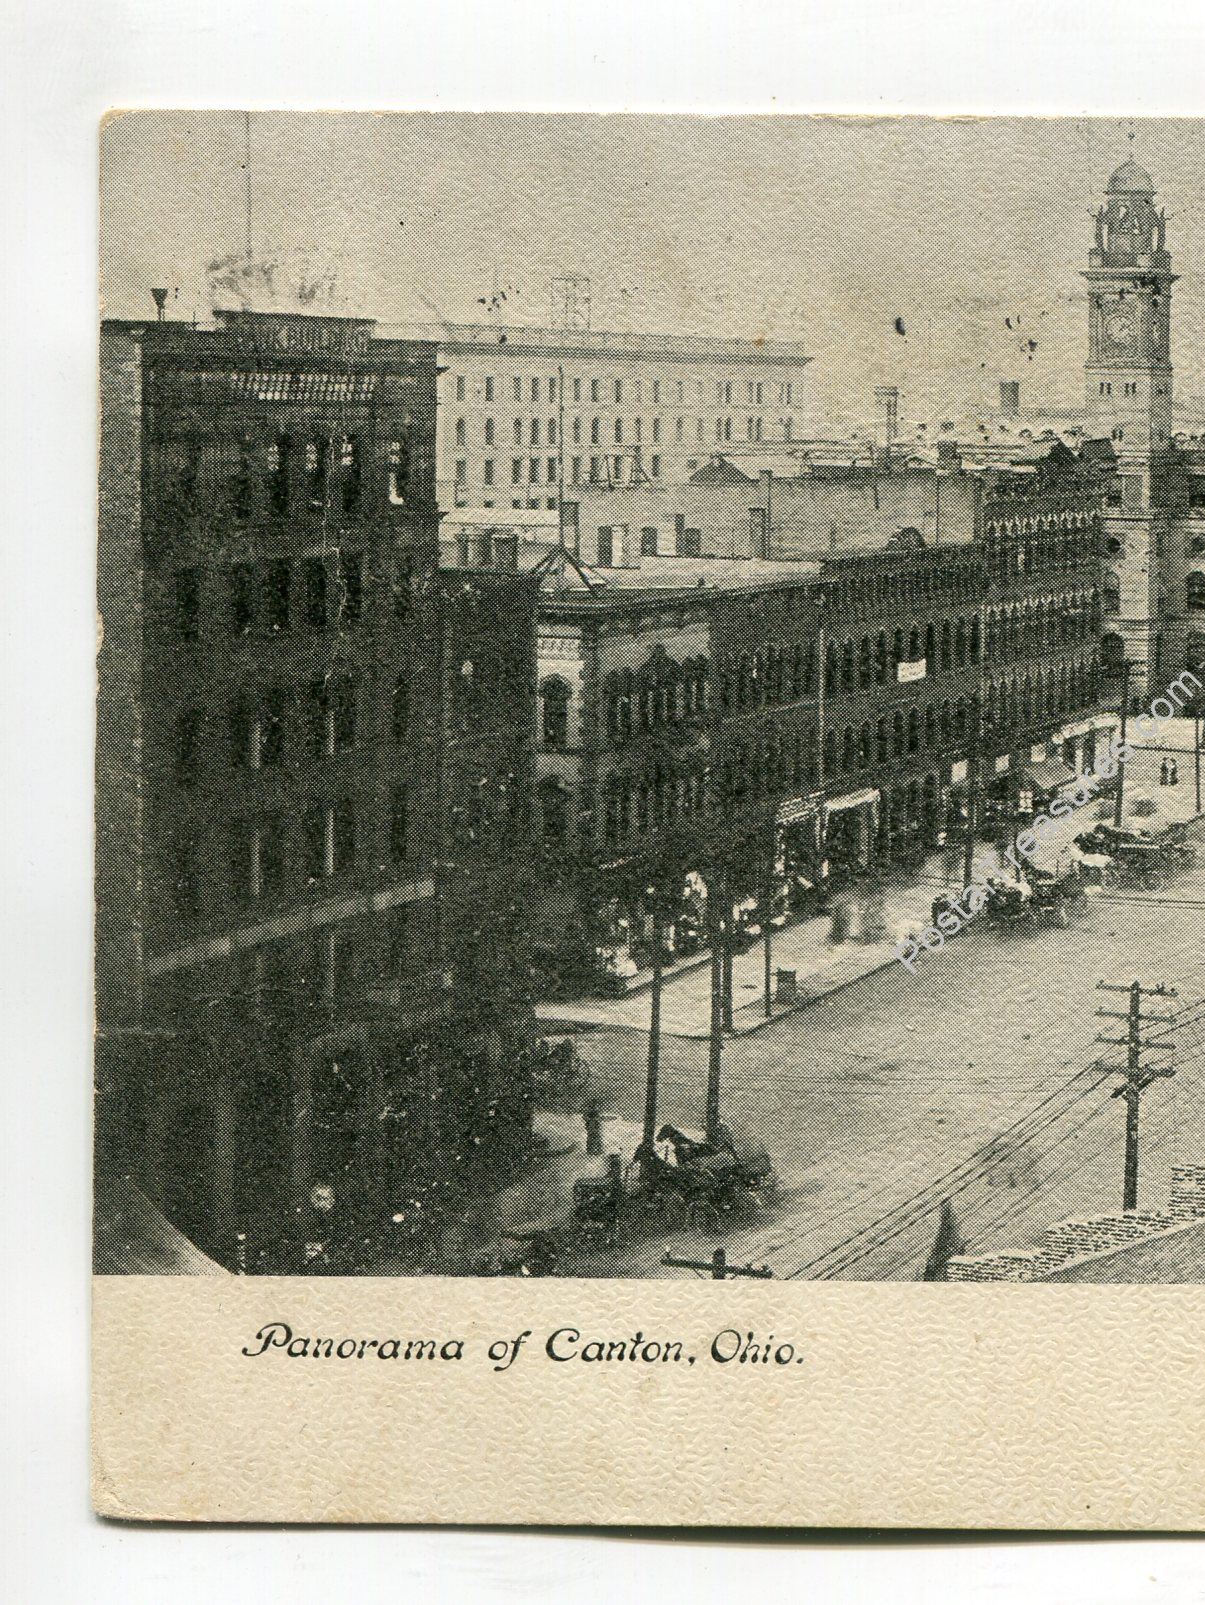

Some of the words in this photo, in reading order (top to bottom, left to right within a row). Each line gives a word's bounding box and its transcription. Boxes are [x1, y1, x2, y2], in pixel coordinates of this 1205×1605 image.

[241, 1322, 464, 1360] Panorama
[488, 1330, 531, 1371] of
[545, 1328, 695, 1364] Canton,
[710, 1329, 803, 1364] Ohio.
